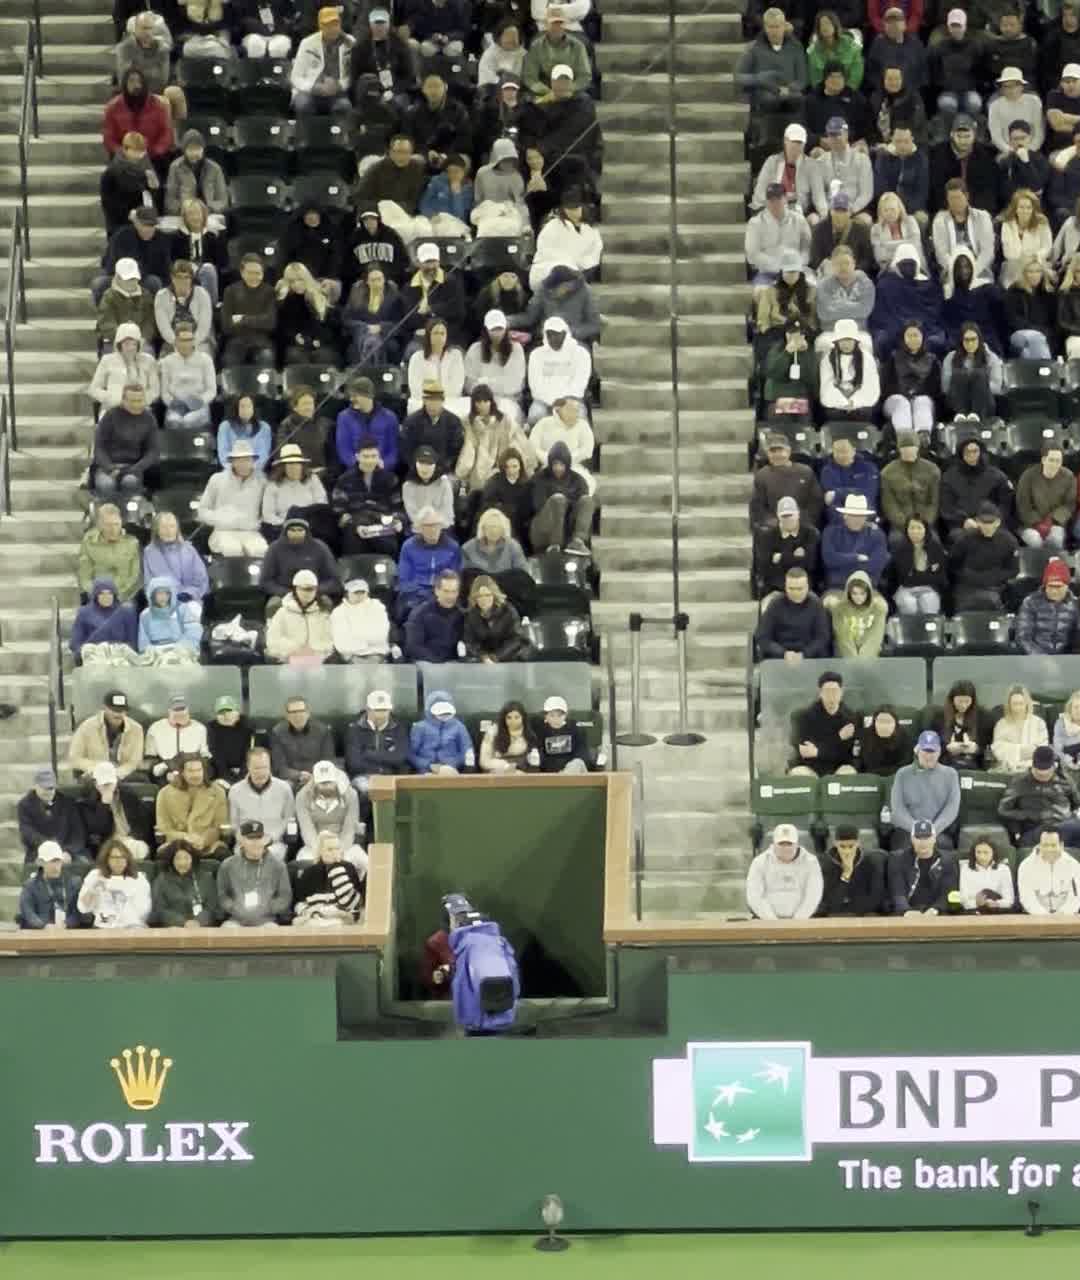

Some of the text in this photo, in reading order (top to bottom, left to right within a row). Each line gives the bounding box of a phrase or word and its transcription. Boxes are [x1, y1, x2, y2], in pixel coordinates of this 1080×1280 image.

[839, 1069, 998, 1130] BNP
[34, 1121, 254, 1164] ROLEX
[838, 1159, 902, 1189] The
[915, 1158, 1000, 1189] bank
[1007, 1156, 1061, 1195] for
